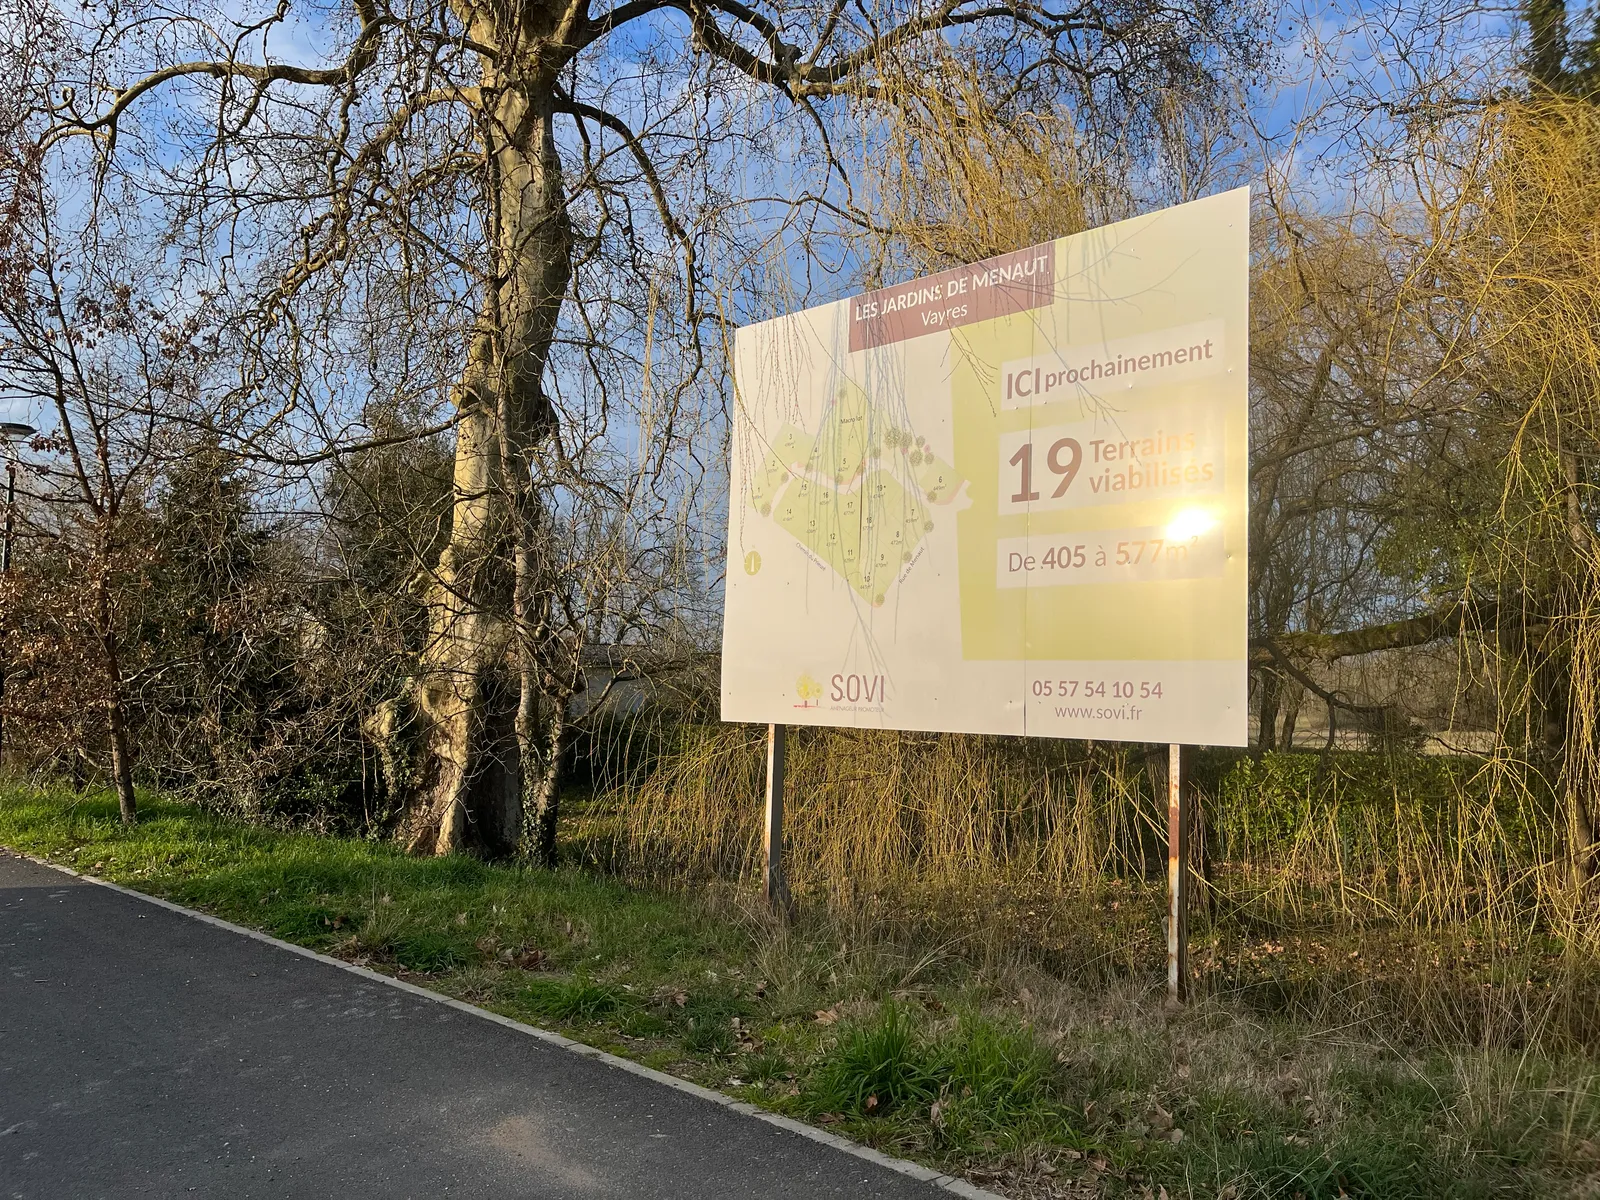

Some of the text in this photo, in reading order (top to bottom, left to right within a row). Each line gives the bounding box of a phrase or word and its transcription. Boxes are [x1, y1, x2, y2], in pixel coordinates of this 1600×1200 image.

[855, 255, 1048, 321] LES JARDINS DE MENAUT
[921, 304, 968, 326] Vayres
[1006, 339, 1213, 399] ICI prochainement
[1008, 430, 1195, 503] 19 Terrains
[1089, 458, 1214, 493] viabilisés
[909, 546, 925, 567] Menaut
[1008, 552, 1036, 572] De
[1042, 545, 1086, 570] 405
[1094, 545, 1108, 567] à
[830, 674, 885, 703] SOVI
[1032, 680, 1163, 699] 05 57 54 10 54
[1055, 704, 1143, 721] www.sovi.fr
